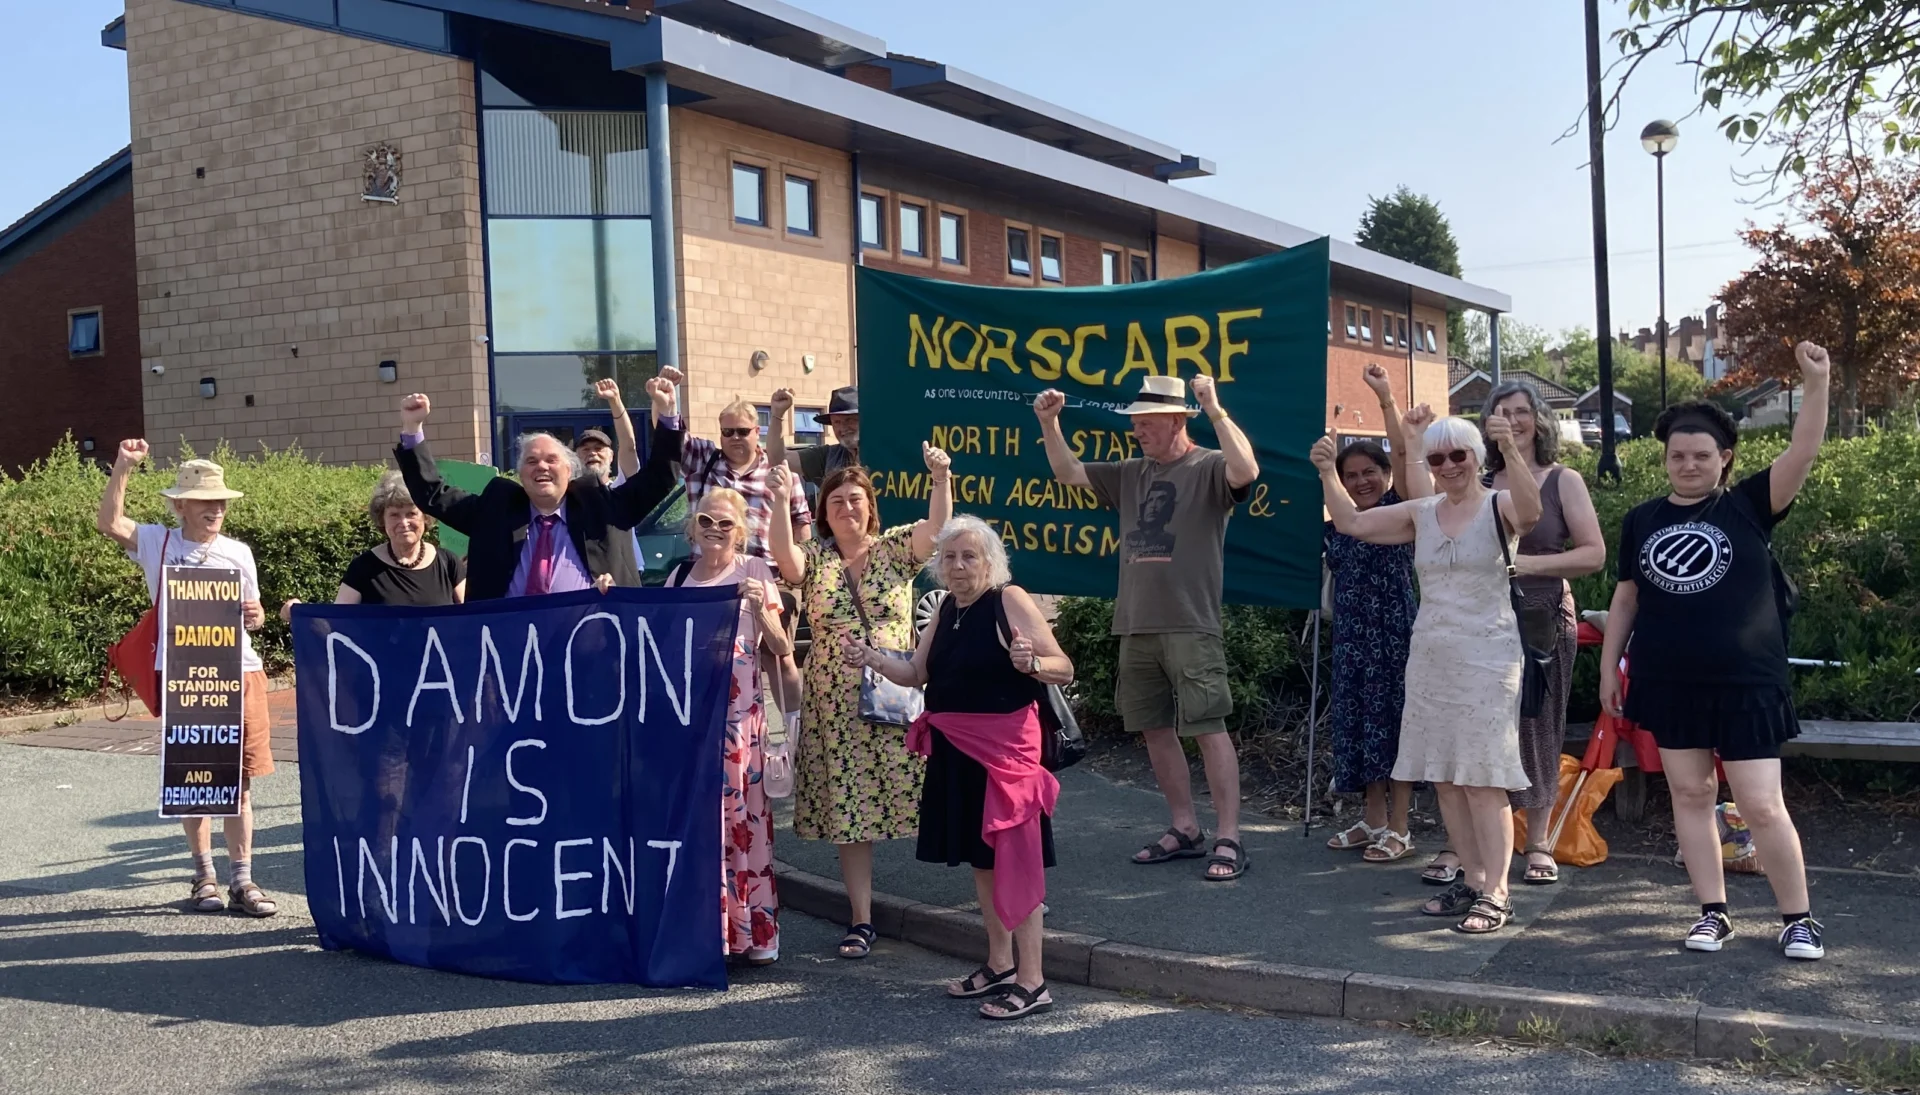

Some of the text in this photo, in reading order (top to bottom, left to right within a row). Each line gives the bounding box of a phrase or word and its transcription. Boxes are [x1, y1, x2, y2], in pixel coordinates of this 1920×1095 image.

[908, 308, 1262, 385] NORSCARF
[924, 389, 936, 399] AS
[931, 426, 1019, 456] NORTH
[1071, 430, 1138, 461] STAF
[869, 470, 1111, 511] CAMPIGN AGAINS
[1644, 559, 1728, 592] ALWAYS ANTIFASCIST
[168, 580, 240, 601] THANKYOU
[174, 625, 236, 647] DAMON
[188, 666, 219, 678] FOR
[326, 611, 694, 735] DAMON
[168, 680, 240, 692] STANDING
[180, 694, 228, 707] UP FOR
[167, 724, 239, 744] JUSTICE
[184, 770, 213, 783] AND
[460, 738, 548, 826] IS
[164, 785, 237, 805] DEMOCRACY
[333, 835, 682, 927] INNOCENT
